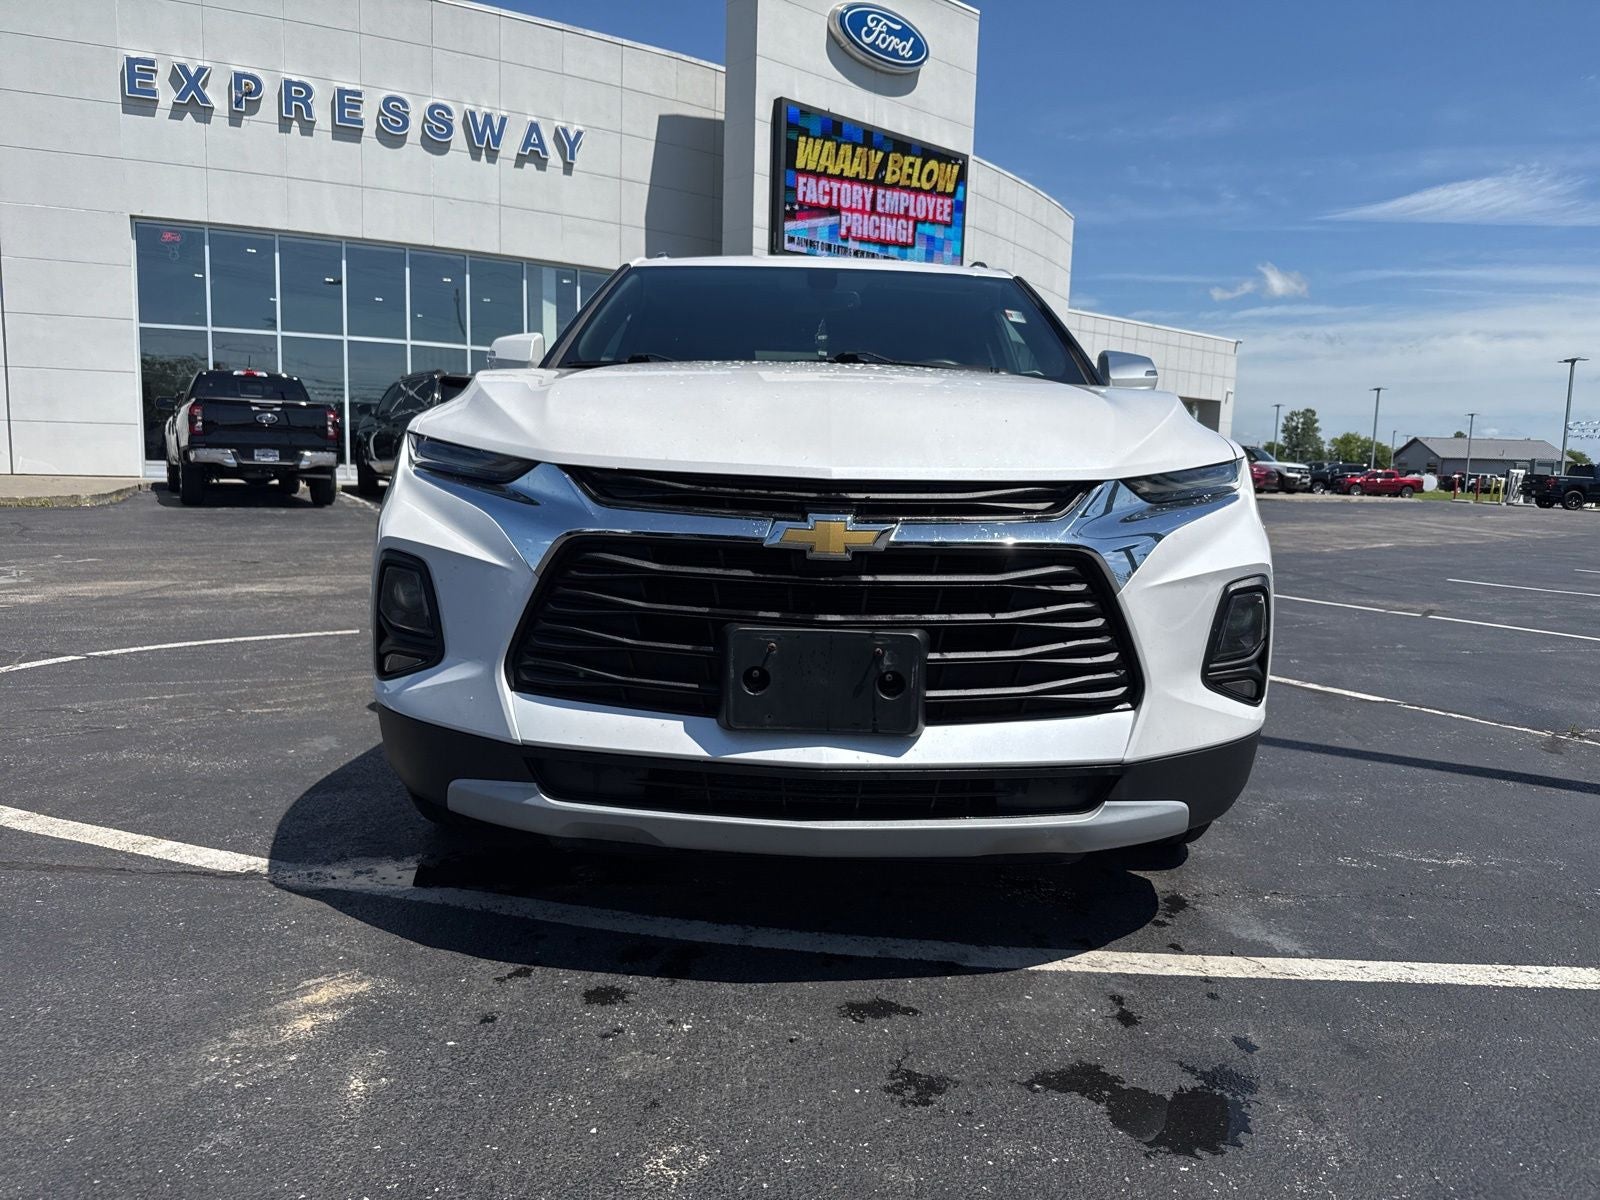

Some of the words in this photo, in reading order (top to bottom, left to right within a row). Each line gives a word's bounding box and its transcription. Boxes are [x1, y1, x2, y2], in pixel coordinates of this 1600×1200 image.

[861, 14, 915, 58] Ford
[123, 54, 586, 163] EXPRESSWAY
[795, 136, 884, 181] WAAAY
[884, 153, 961, 194] BELOW
[797, 175, 874, 212] FACTORY
[876, 187, 953, 223] EMPLOYEE
[840, 211, 914, 245] PRICING!
